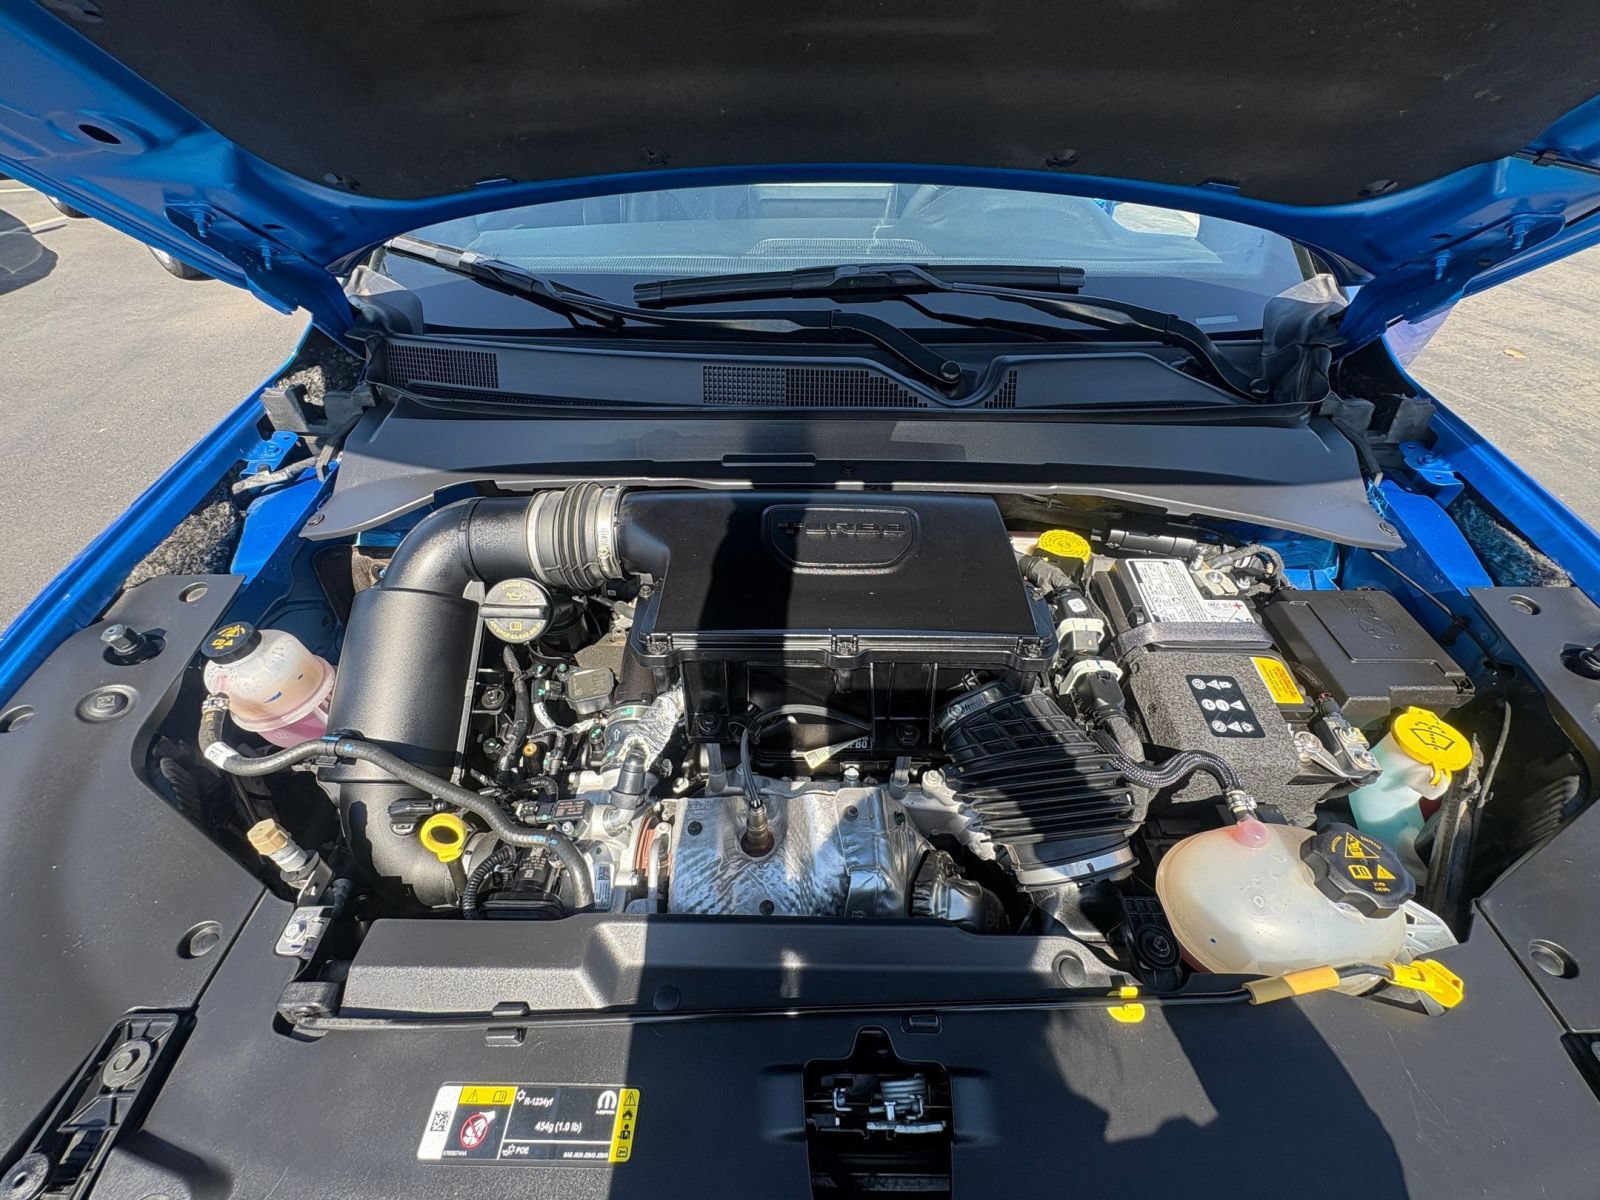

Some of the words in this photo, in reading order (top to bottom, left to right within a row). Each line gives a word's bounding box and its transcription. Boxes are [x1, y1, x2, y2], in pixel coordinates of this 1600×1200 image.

[523, 1097, 554, 1107] R-1234yf
[534, 1121, 553, 1133] 454g
[554, 1121, 570, 1134] (1.0
[570, 1121, 582, 1134] lb)
[515, 1146, 530, 1155] POE
